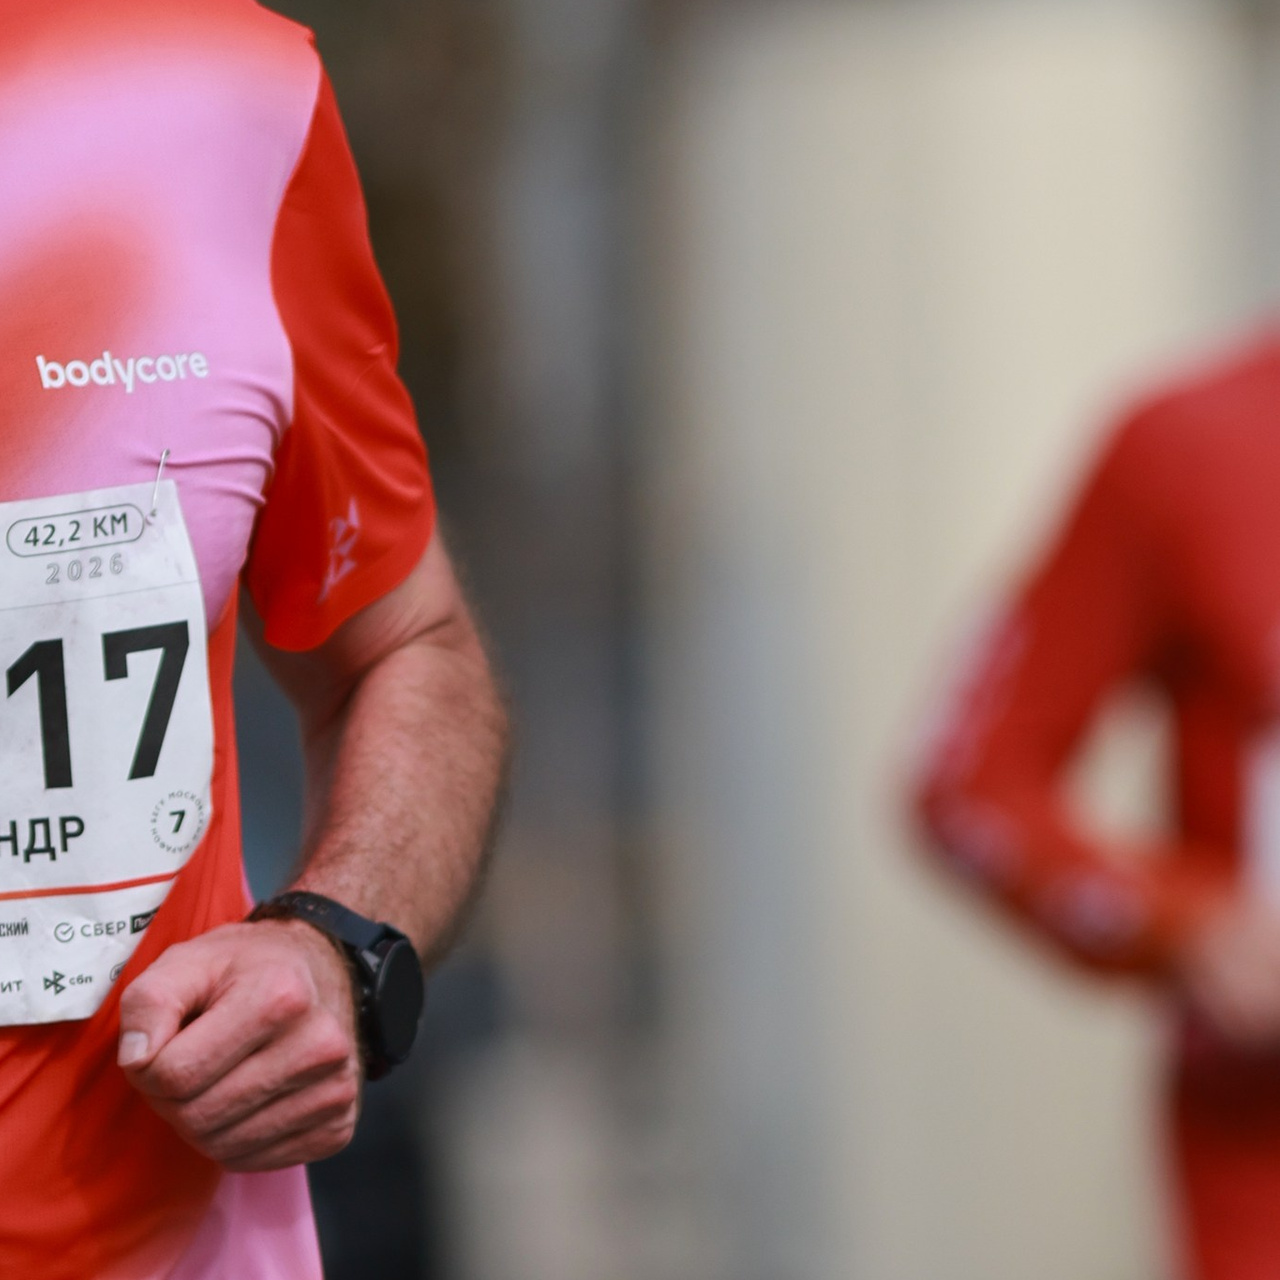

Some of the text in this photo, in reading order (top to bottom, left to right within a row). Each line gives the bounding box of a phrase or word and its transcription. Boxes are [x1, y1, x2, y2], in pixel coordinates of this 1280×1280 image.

[36, 351, 209, 394] bodycore
[24, 512, 128, 548] 42,2 КМ
[45, 552, 124, 585] 2026
[169, 809, 185, 833] 7
[80, 921, 126, 938] СБЕР
